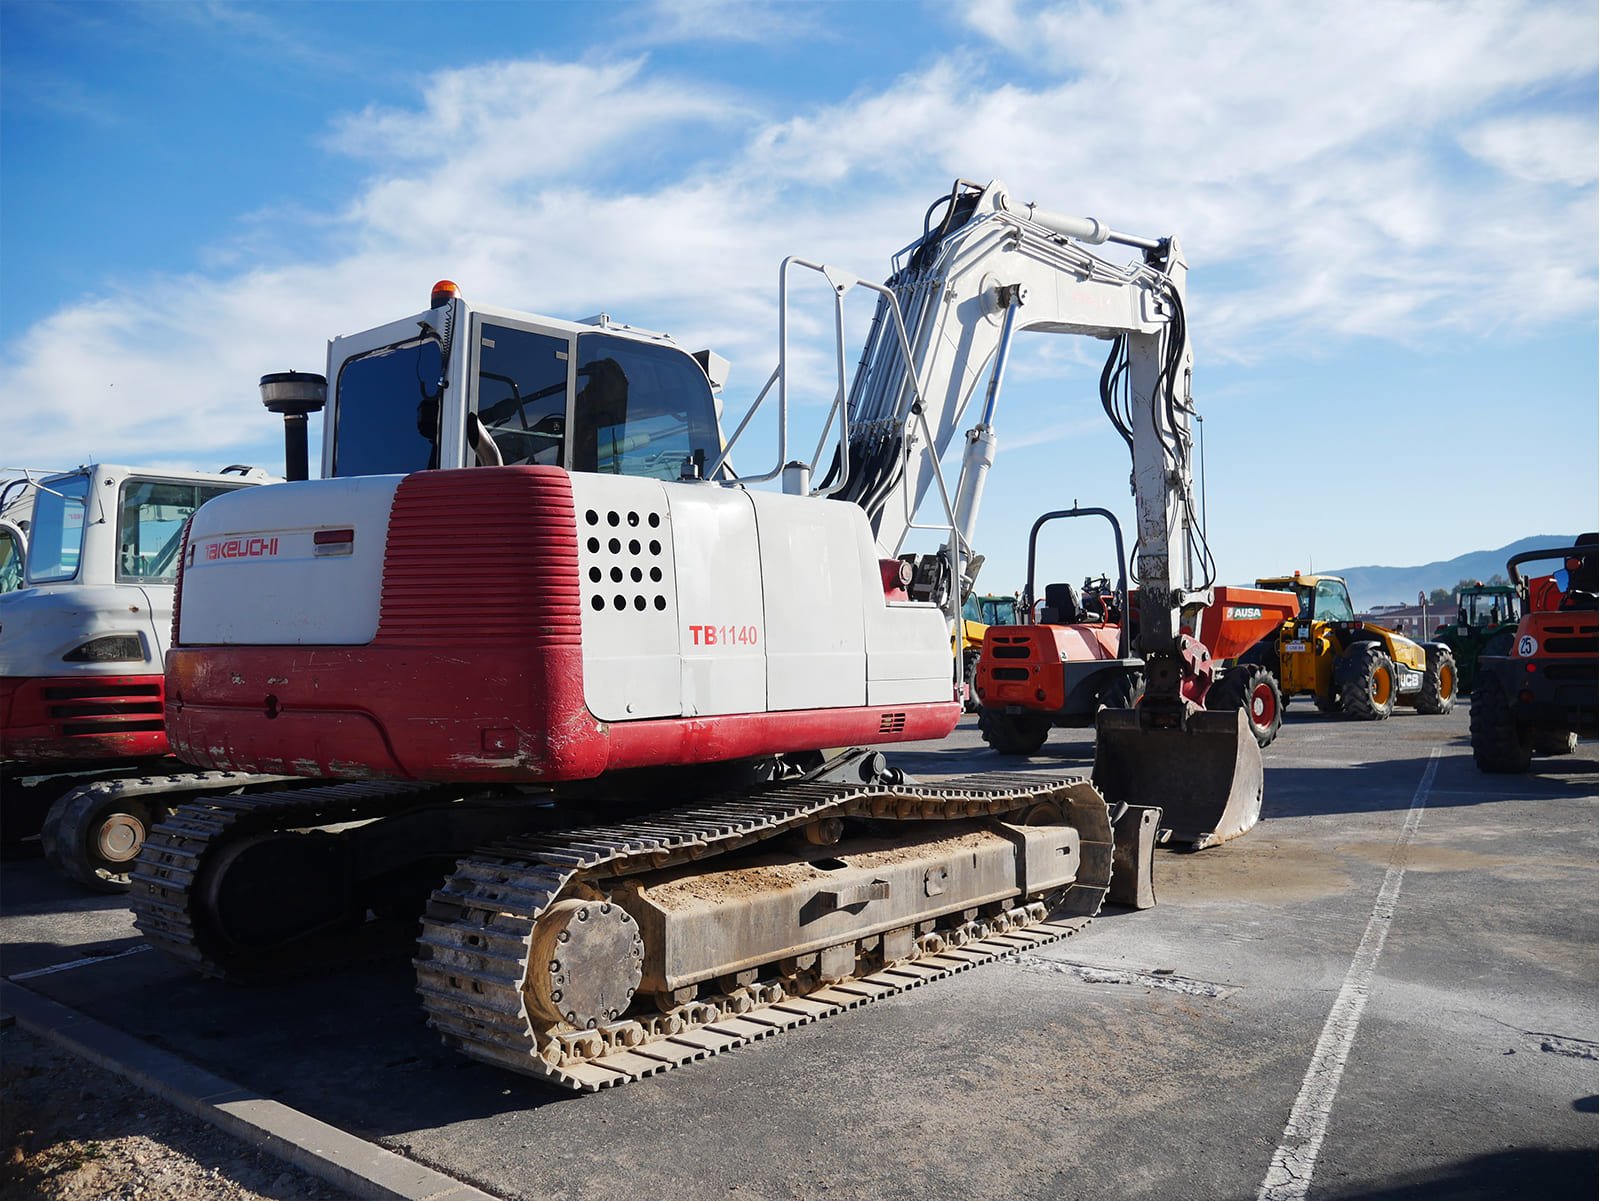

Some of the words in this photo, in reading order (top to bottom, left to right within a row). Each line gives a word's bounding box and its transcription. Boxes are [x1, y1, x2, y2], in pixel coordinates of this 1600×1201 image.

[1233, 607, 1261, 618] AUSA
[689, 625, 758, 645] TB1140
[1520, 637, 1532, 654] 25
[1400, 673, 1419, 687] JCB
